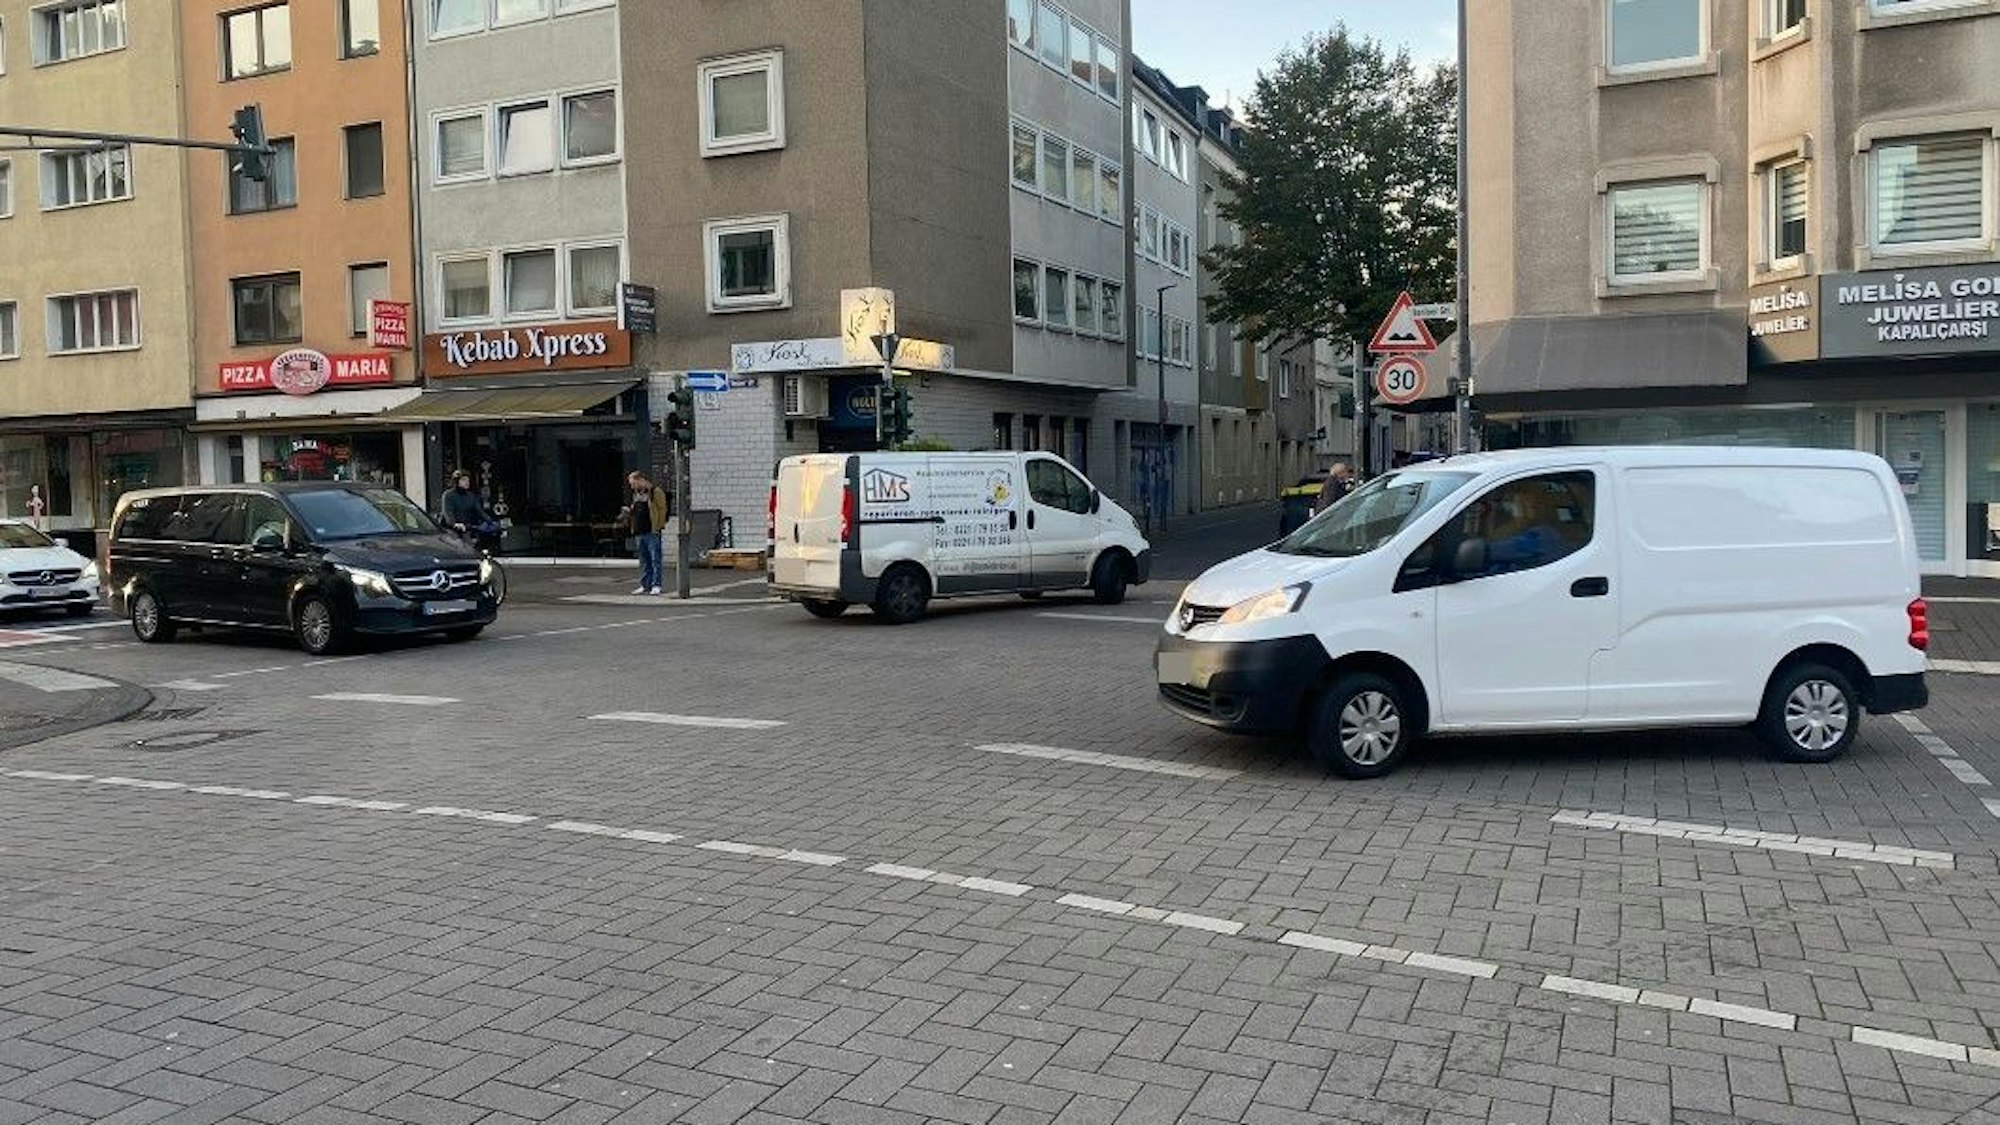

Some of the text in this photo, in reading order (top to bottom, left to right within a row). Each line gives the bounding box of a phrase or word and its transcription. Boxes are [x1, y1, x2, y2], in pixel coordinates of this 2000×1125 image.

[375, 317, 406, 332] PIZZA
[375, 332, 407, 346] MARIA
[440, 328, 607, 368] Kebab Xpress
[222, 367, 267, 384] PIZZA
[336, 359, 389, 378] MARIA
[1388, 369, 1415, 390] 30
[864, 474, 910, 503] HMS
